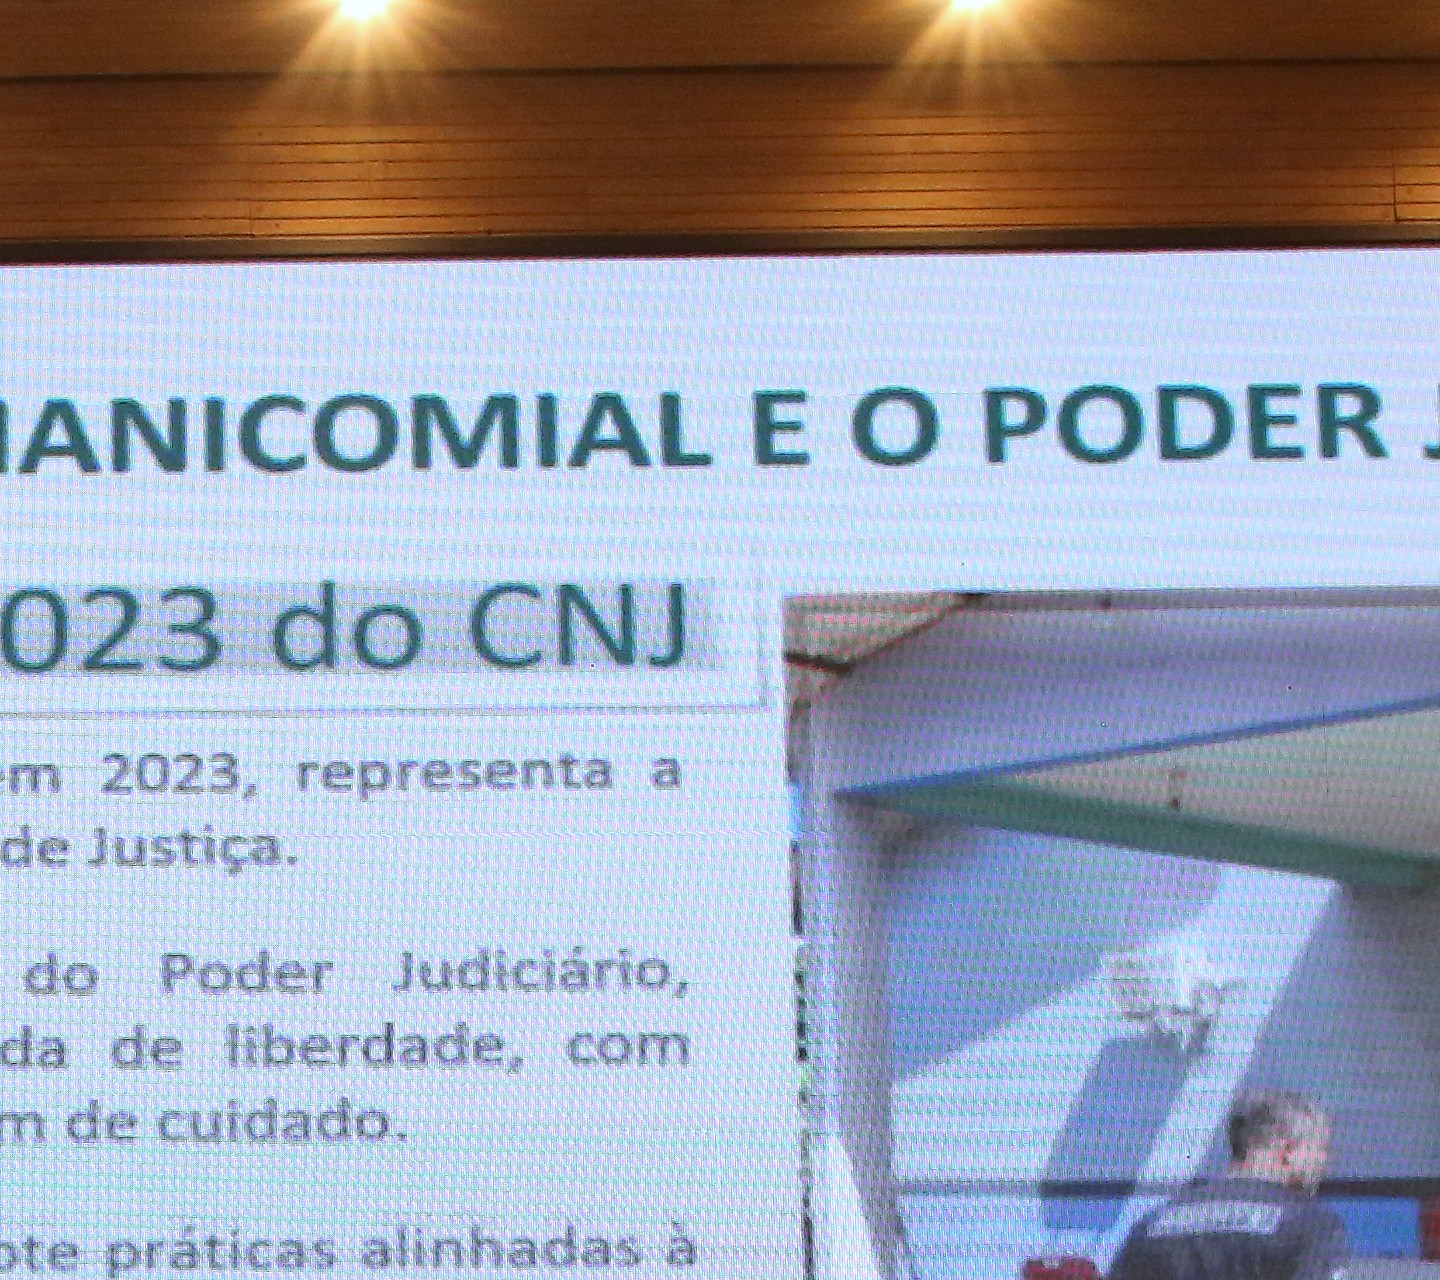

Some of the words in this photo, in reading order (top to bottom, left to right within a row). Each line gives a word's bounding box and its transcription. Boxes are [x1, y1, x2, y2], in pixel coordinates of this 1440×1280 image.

[753, 390, 810, 467] E
[851, 385, 941, 467] O
[982, 383, 1388, 464] PODER
[270, 580, 425, 675] do
[468, 581, 689, 672] CNJ
[101, 751, 257, 800] 2023,
[296, 753, 613, 801] representa
[651, 757, 682, 789] a
[88, 825, 297, 876] Justiça.
[24, 951, 99, 997] do
[161, 949, 334, 995] Poder
[393, 945, 689, 998] Judiciário,
[110, 1024, 183, 1070] de
[226, 1021, 523, 1073] liberdade,
[566, 1032, 690, 1066] com
[66, 1099, 138, 1144] de
[157, 1097, 407, 1143] cuidado.
[105, 1225, 337, 1280] práticas
[361, 1224, 643, 1269] alinhadas
[665, 1220, 698, 1267] à
